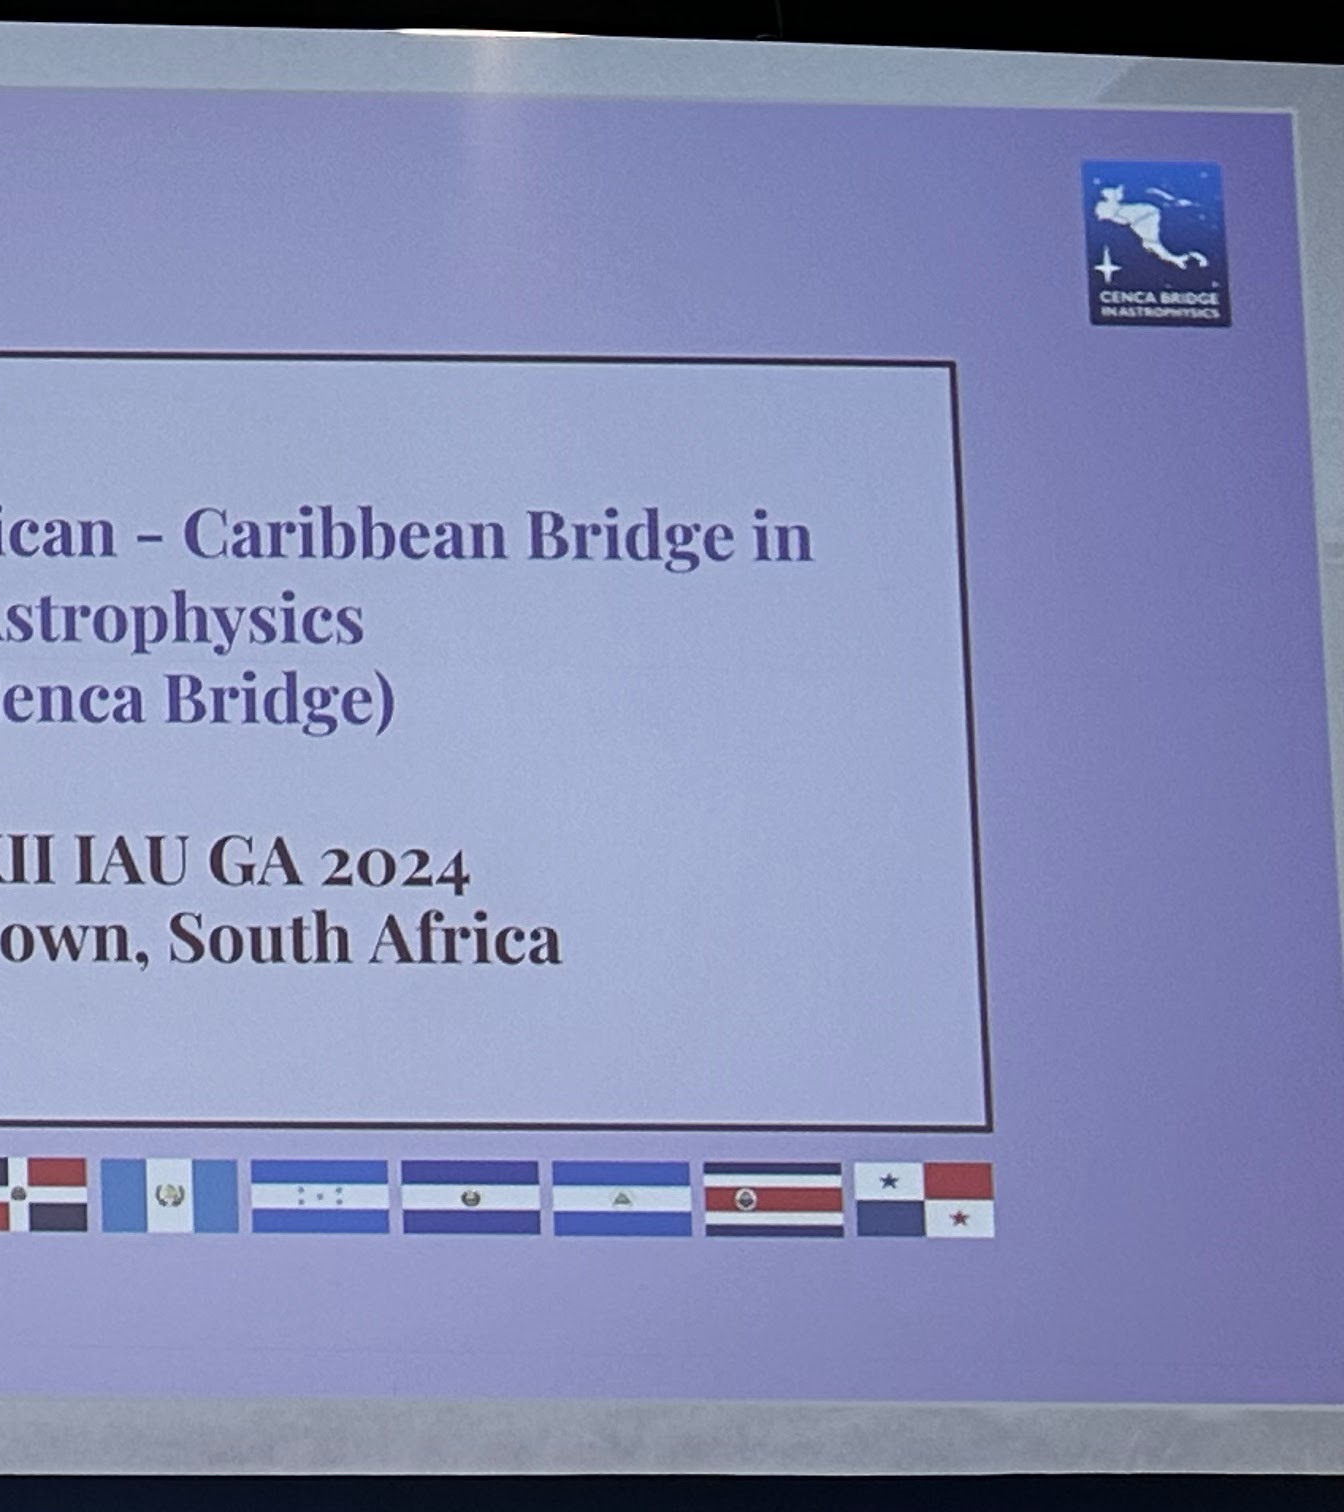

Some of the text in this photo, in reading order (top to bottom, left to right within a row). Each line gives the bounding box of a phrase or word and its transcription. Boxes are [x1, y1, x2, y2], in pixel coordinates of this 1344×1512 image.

[184, 505, 508, 561] Caribbean
[526, 507, 734, 575] Bridge
[752, 508, 814, 562] in
[164, 670, 395, 738] Bridge)
[75, 834, 190, 887] IAU
[209, 834, 304, 888] GA
[321, 847, 471, 897] 2024
[169, 909, 353, 966] South
[368, 909, 563, 967] Africa
